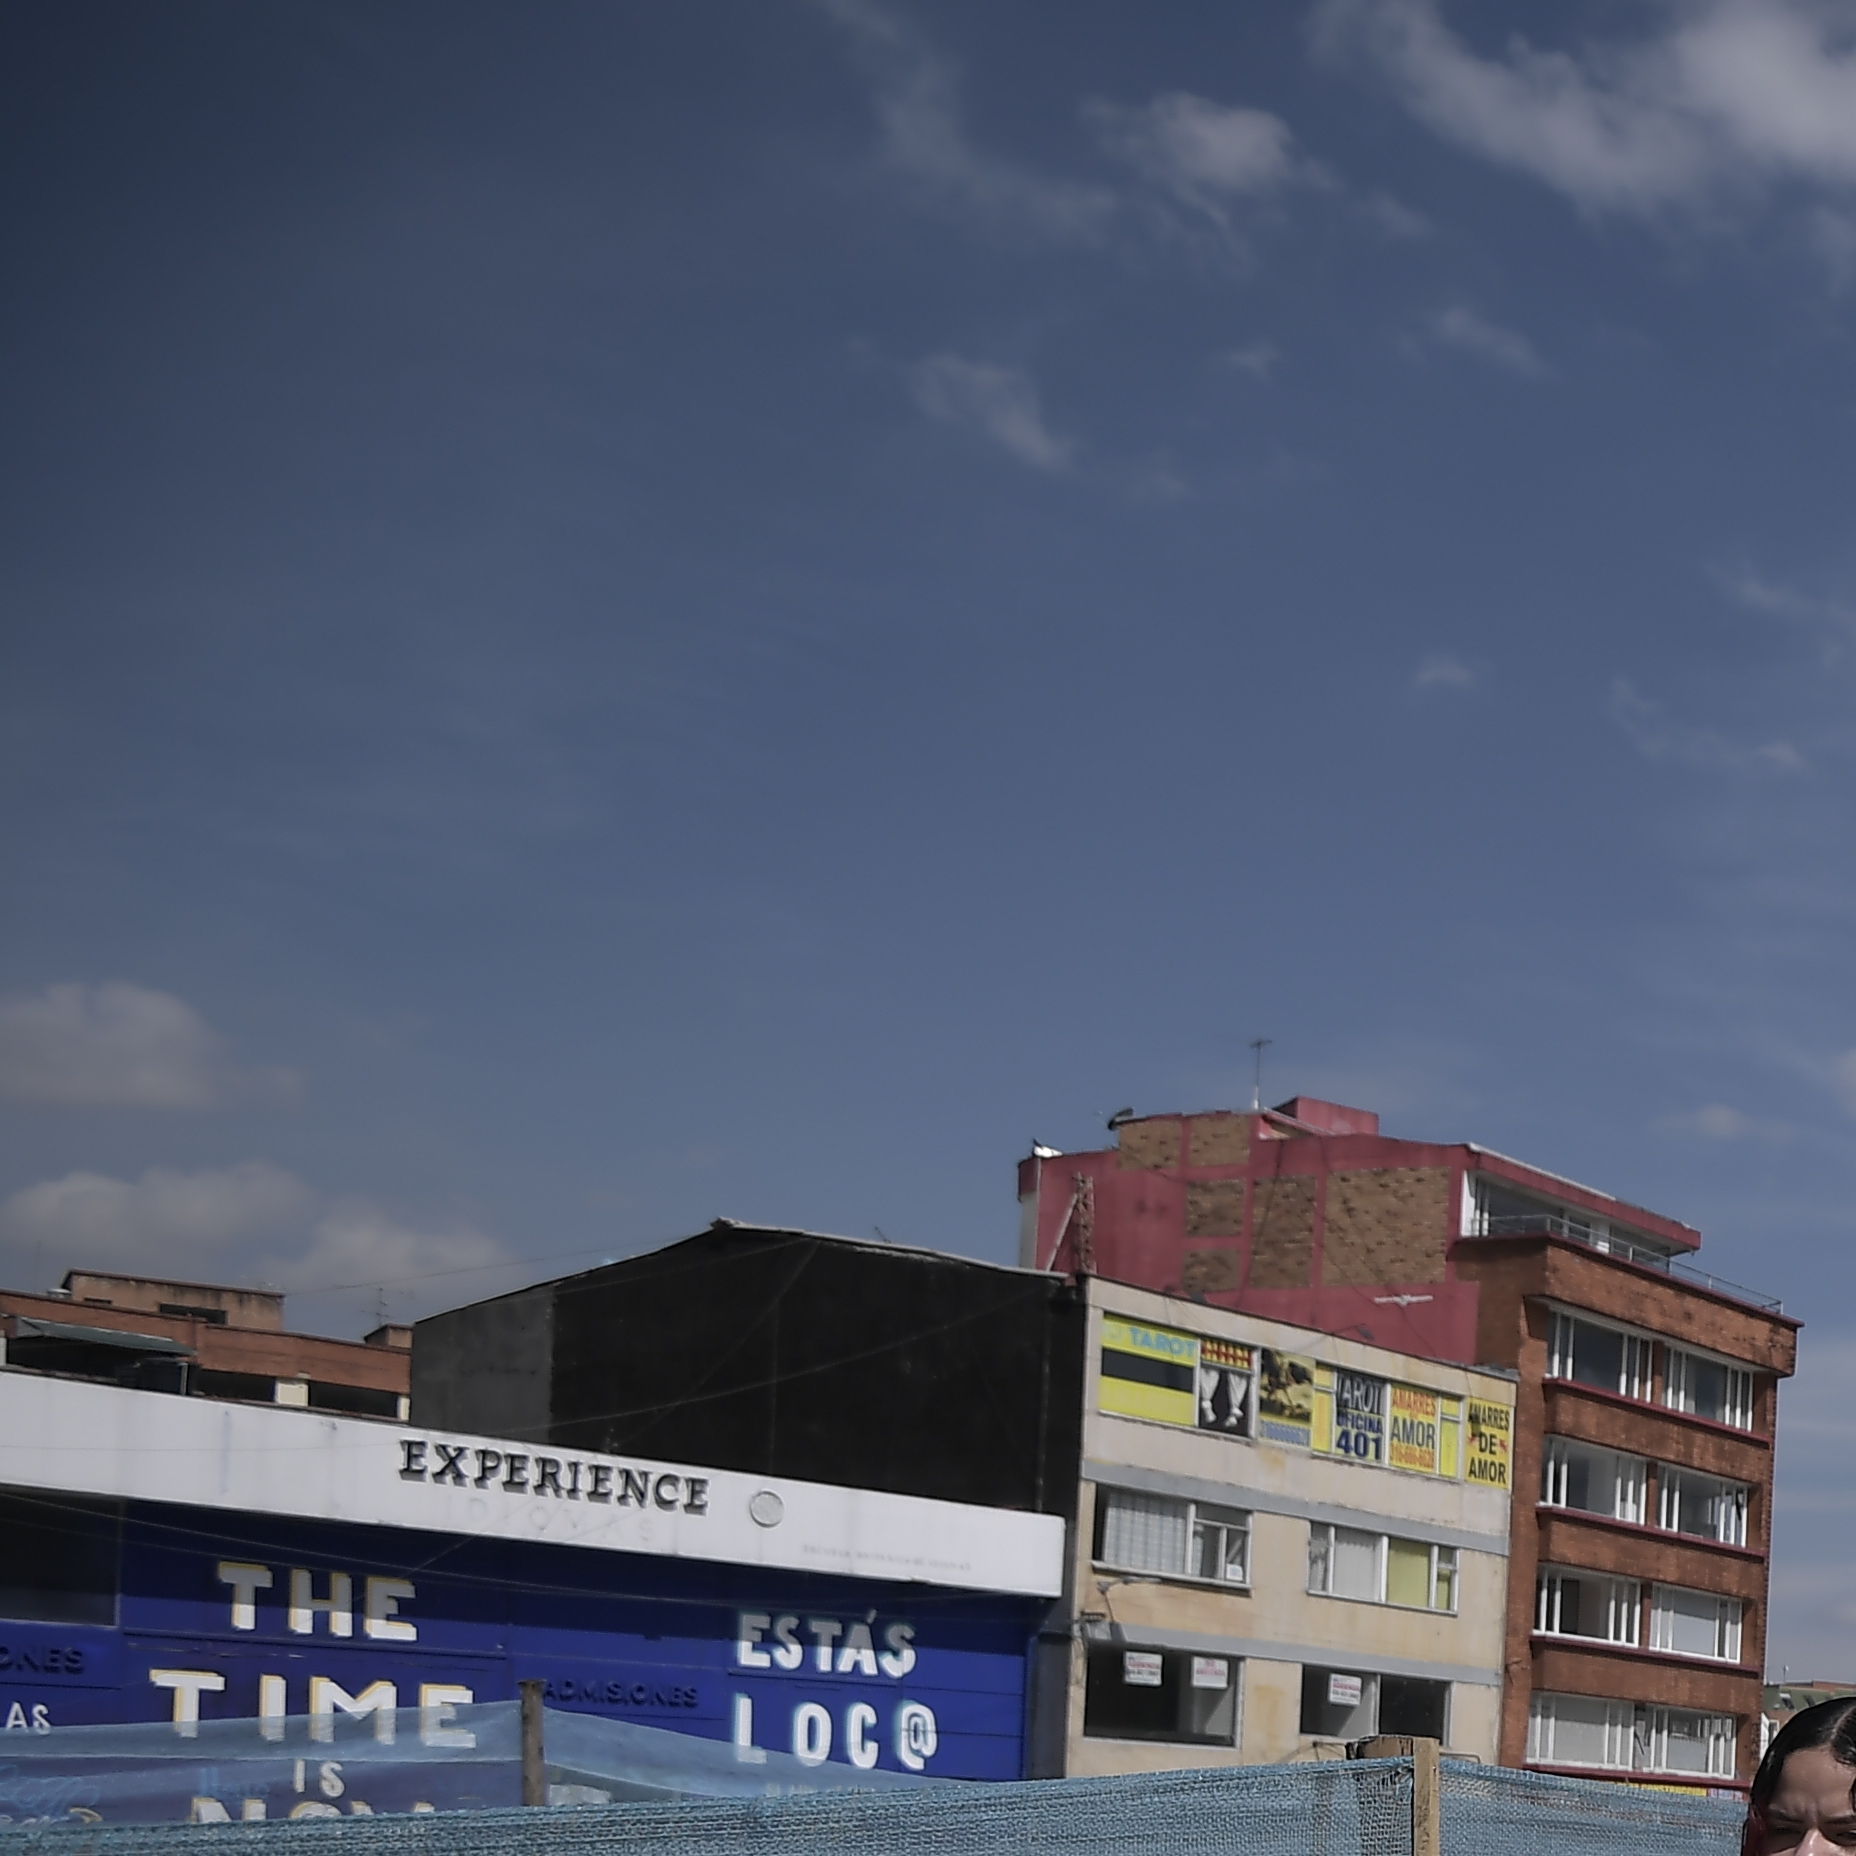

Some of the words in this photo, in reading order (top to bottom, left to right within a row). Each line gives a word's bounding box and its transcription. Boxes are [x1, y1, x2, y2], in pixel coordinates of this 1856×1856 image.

[1129, 1326, 1197, 1357] TAROT
[1337, 1411, 1383, 1435] OFICINA
[1391, 1417, 1435, 1449] AMOR
[1468, 1402, 1510, 1432] AMARRES
[1336, 1429, 1383, 1461] 401
[1479, 1432, 1497, 1456] DE
[399, 1439, 710, 1516] EXPERIENCE
[1468, 1458, 1507, 1485] AMOR
[217, 1561, 418, 1642] THE
[736, 1608, 917, 1680] ESTÁS
[149, 1669, 478, 1748] TIME
[292, 1759, 345, 1798] IS
